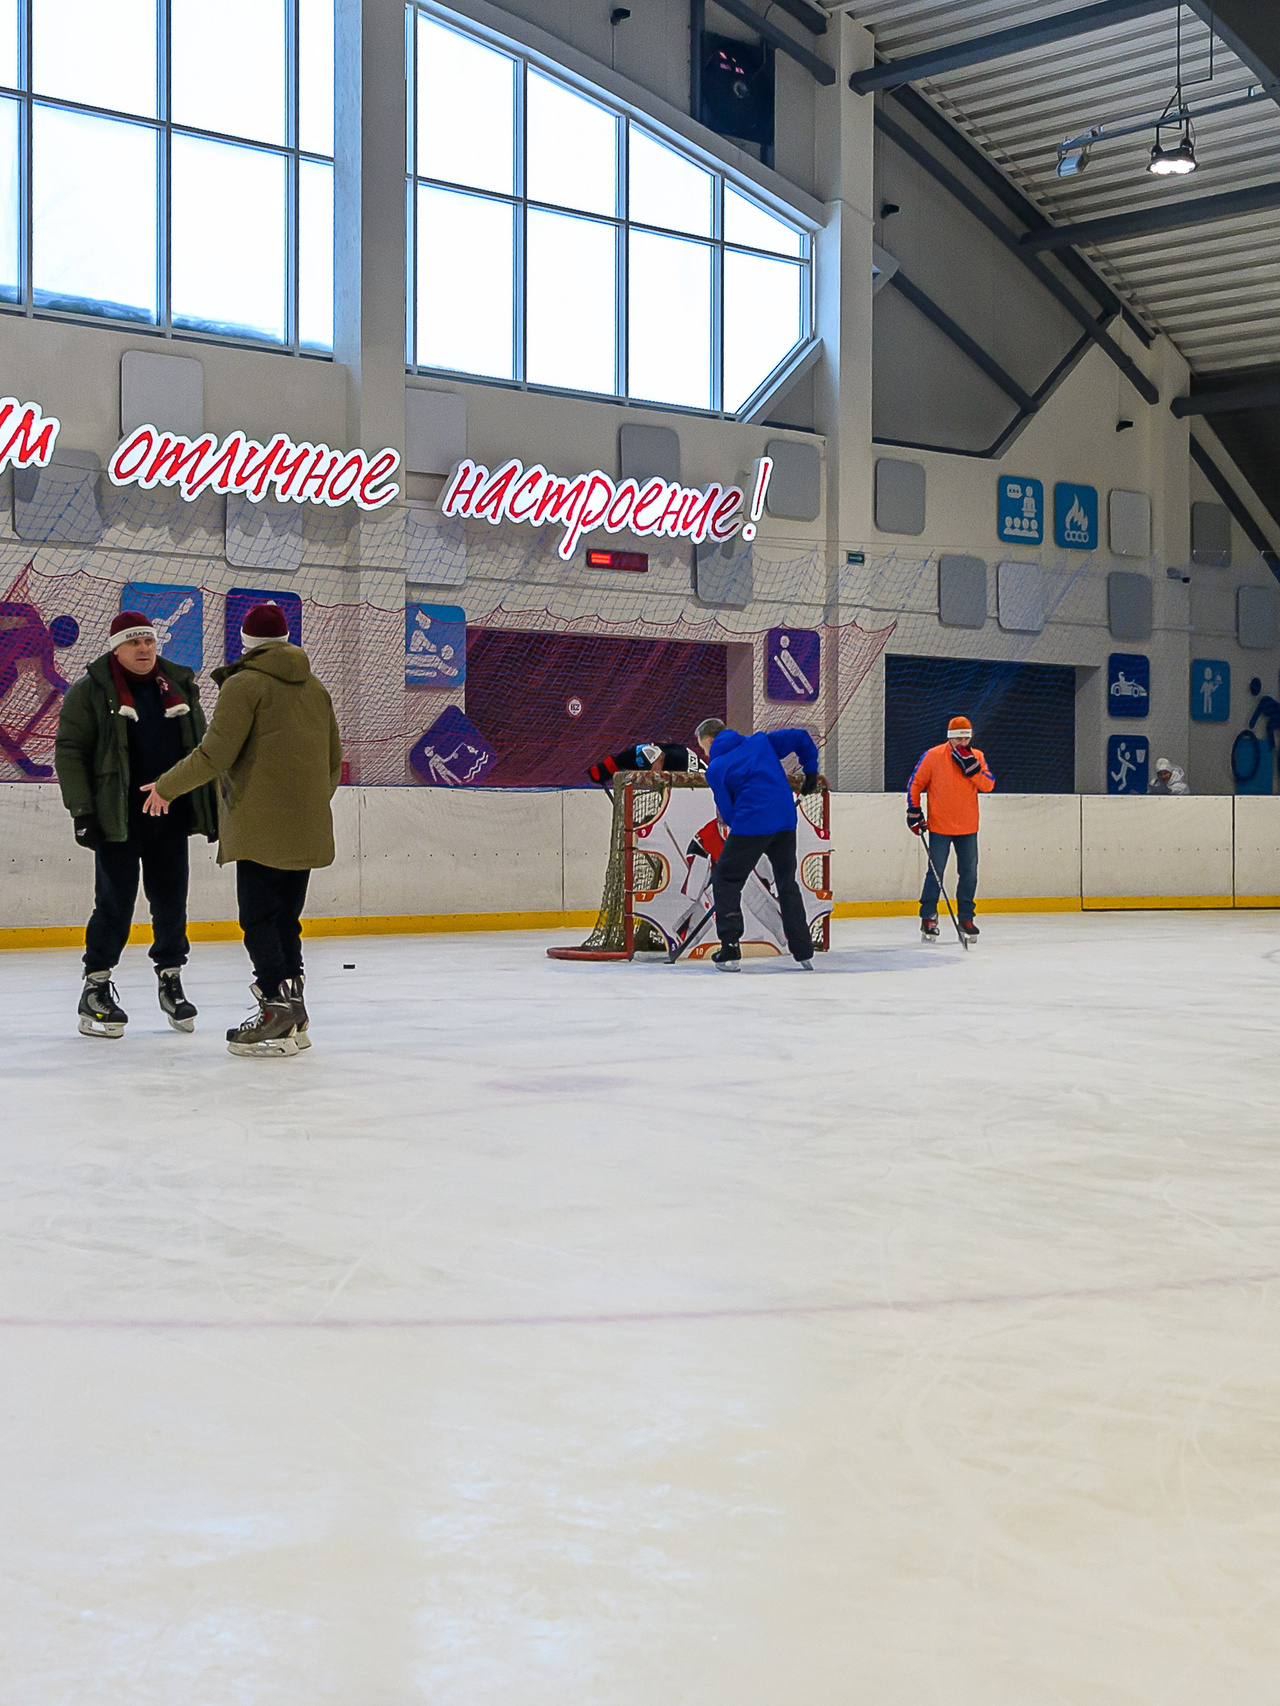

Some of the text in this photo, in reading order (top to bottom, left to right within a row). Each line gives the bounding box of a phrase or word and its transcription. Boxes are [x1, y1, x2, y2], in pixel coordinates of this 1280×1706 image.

[0, 403, 769, 555] м отличное настроение!
[640, 828, 647, 836] 9
[695, 947, 704, 956] 10
